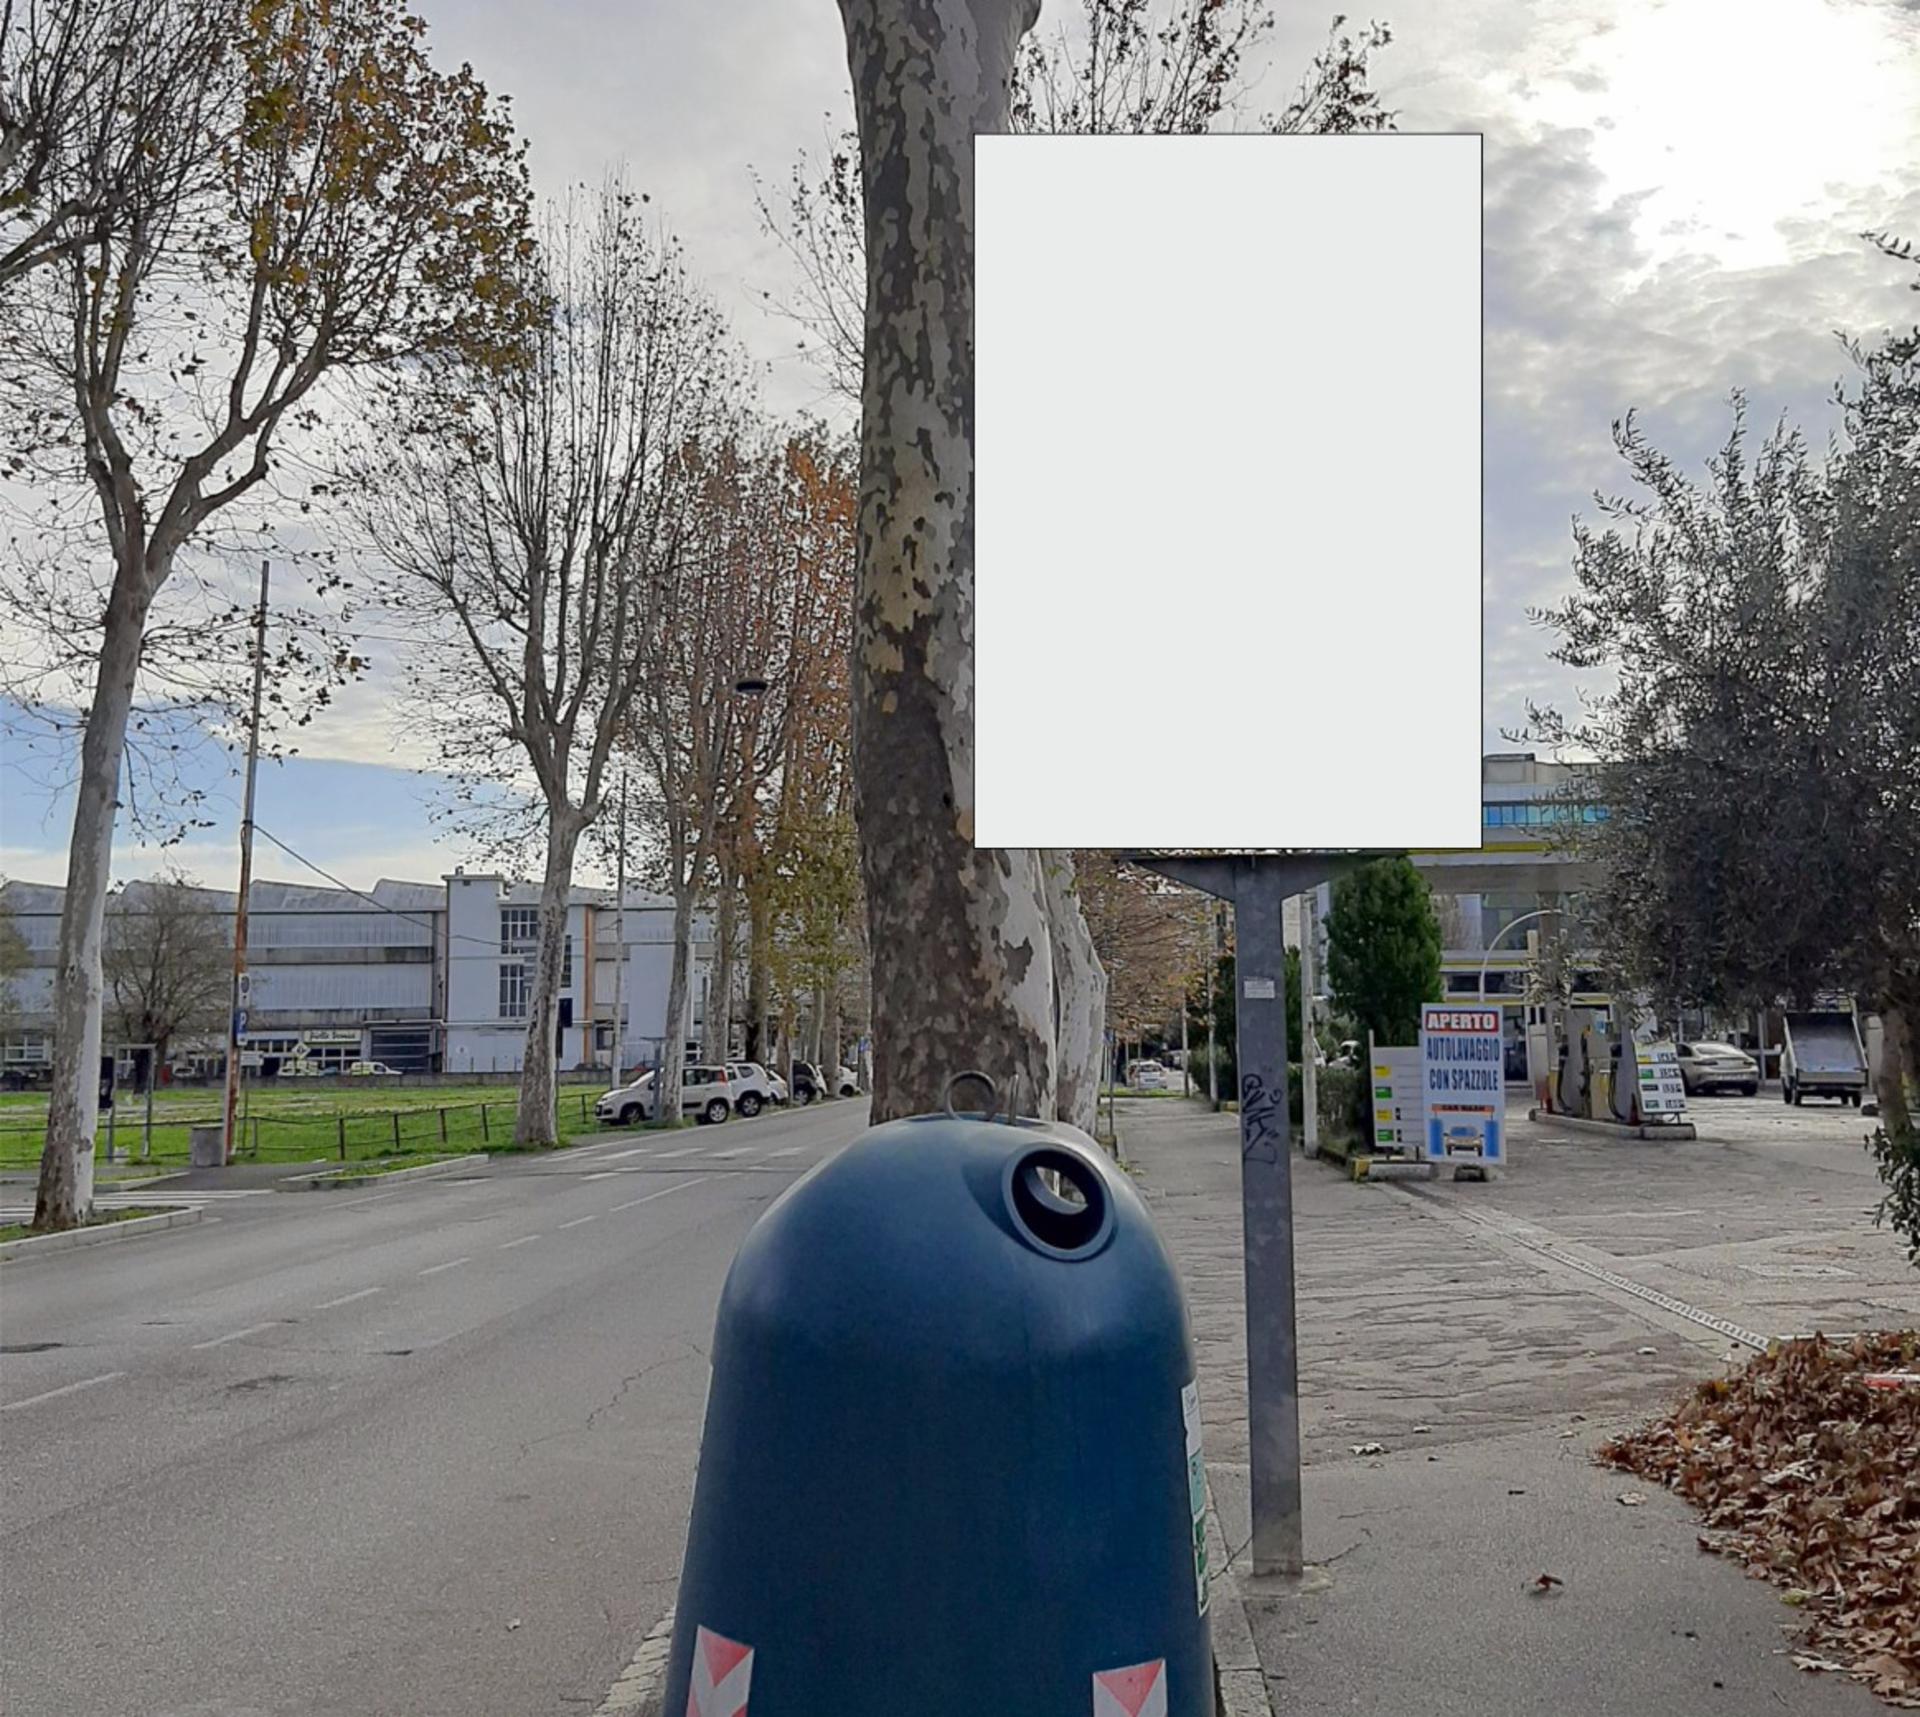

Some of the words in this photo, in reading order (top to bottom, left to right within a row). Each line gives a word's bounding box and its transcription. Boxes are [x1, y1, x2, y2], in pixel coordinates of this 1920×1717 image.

[239, 1012, 247, 1032] P
[1427, 1013, 1495, 1029] APERTO
[1426, 1038, 1499, 1061] AUTOLAVAGGIO
[1429, 1069, 1450, 1090] CON
[1452, 1069, 1498, 1091] SPAZZOLE
